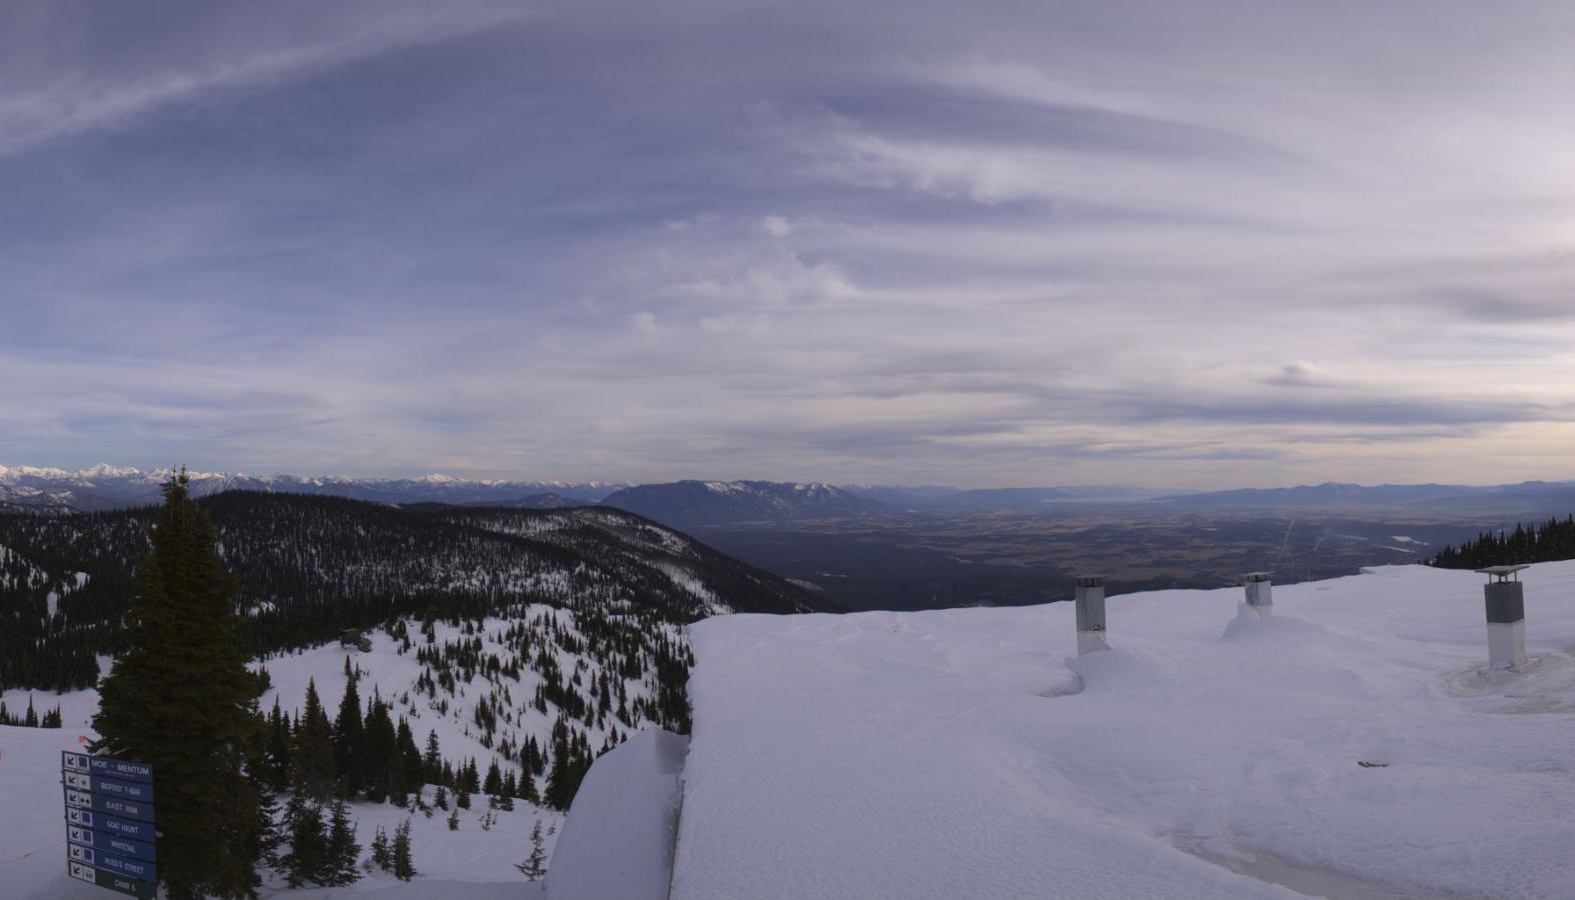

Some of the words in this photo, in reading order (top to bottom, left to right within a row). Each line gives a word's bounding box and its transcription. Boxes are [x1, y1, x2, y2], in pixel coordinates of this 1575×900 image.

[91, 760, 108, 769] MOE
[117, 763, 149, 776] MENTUM
[106, 801, 122, 810] EAST
[114, 879, 131, 889] CHAIR
